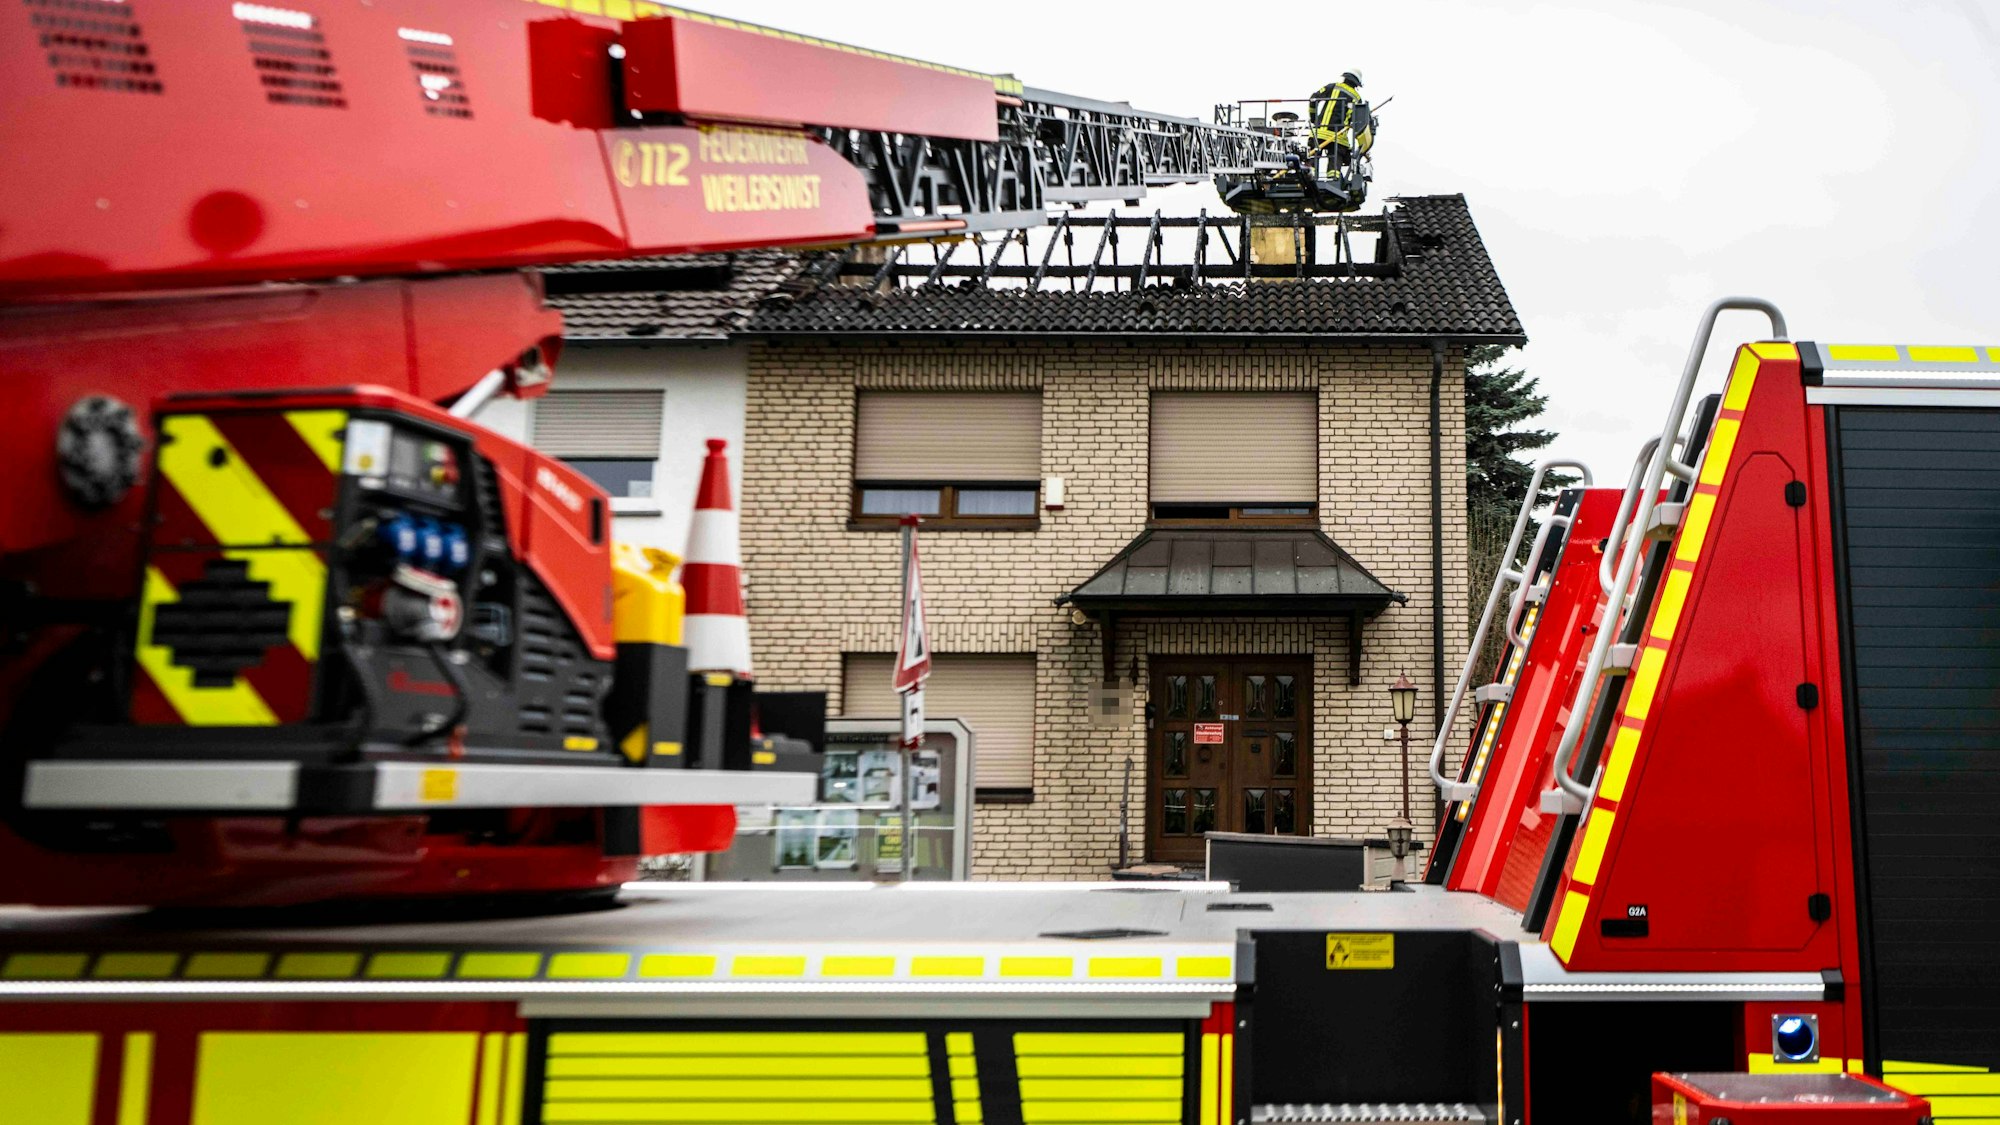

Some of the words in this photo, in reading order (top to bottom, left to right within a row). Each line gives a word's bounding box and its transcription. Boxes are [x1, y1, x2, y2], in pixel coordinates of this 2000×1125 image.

[639, 142, 690, 186] 112
[701, 174, 821, 212] WEILERSWIST
[1628, 906, 1647, 917] G2A
